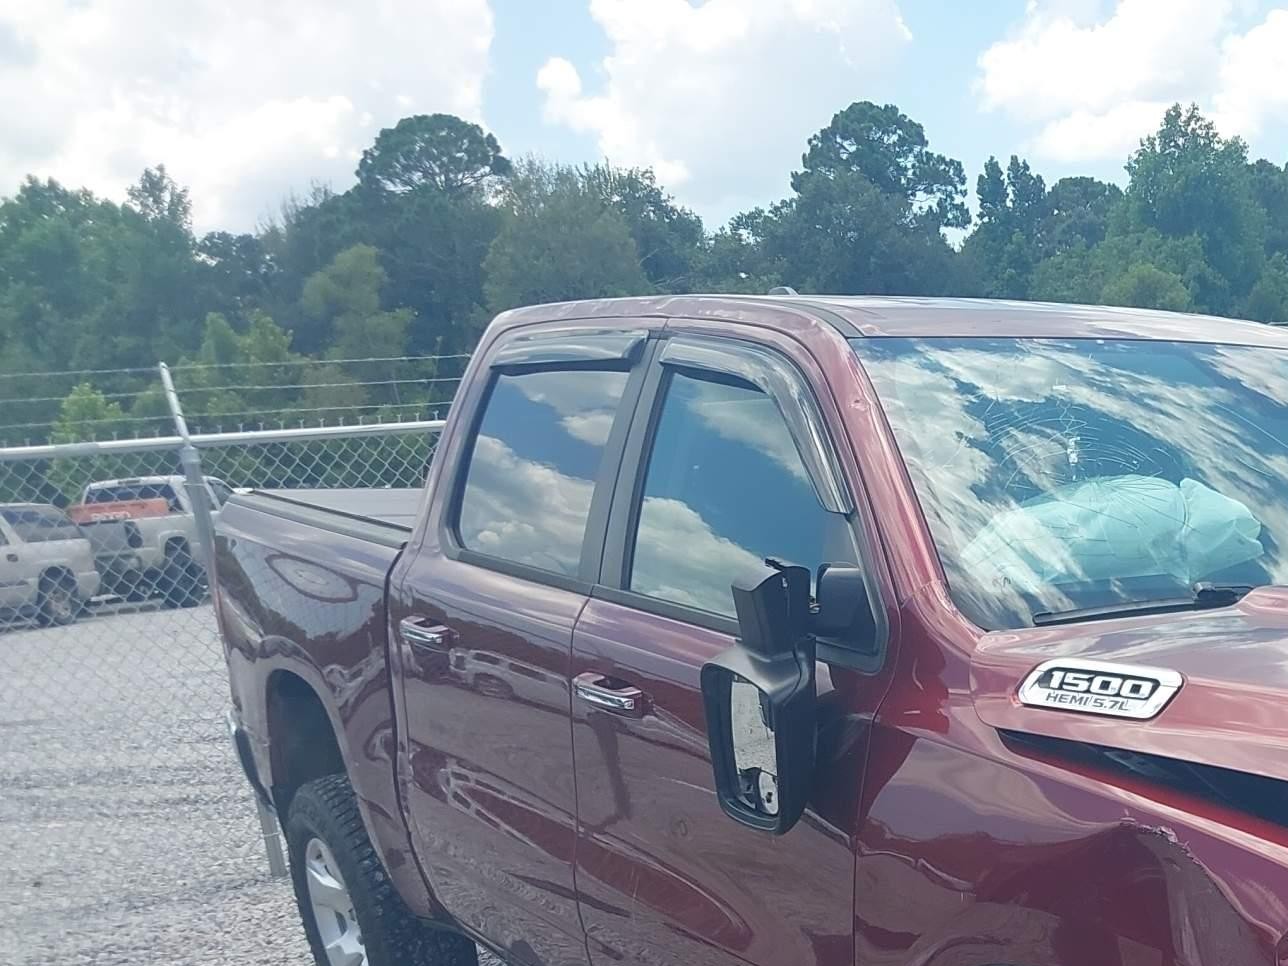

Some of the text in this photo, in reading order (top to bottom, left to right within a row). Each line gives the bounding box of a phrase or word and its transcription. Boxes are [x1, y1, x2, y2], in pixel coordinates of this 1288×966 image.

[1048, 670, 1154, 699] 1500
[1045, 692, 1130, 711] HEMI 5.7L
